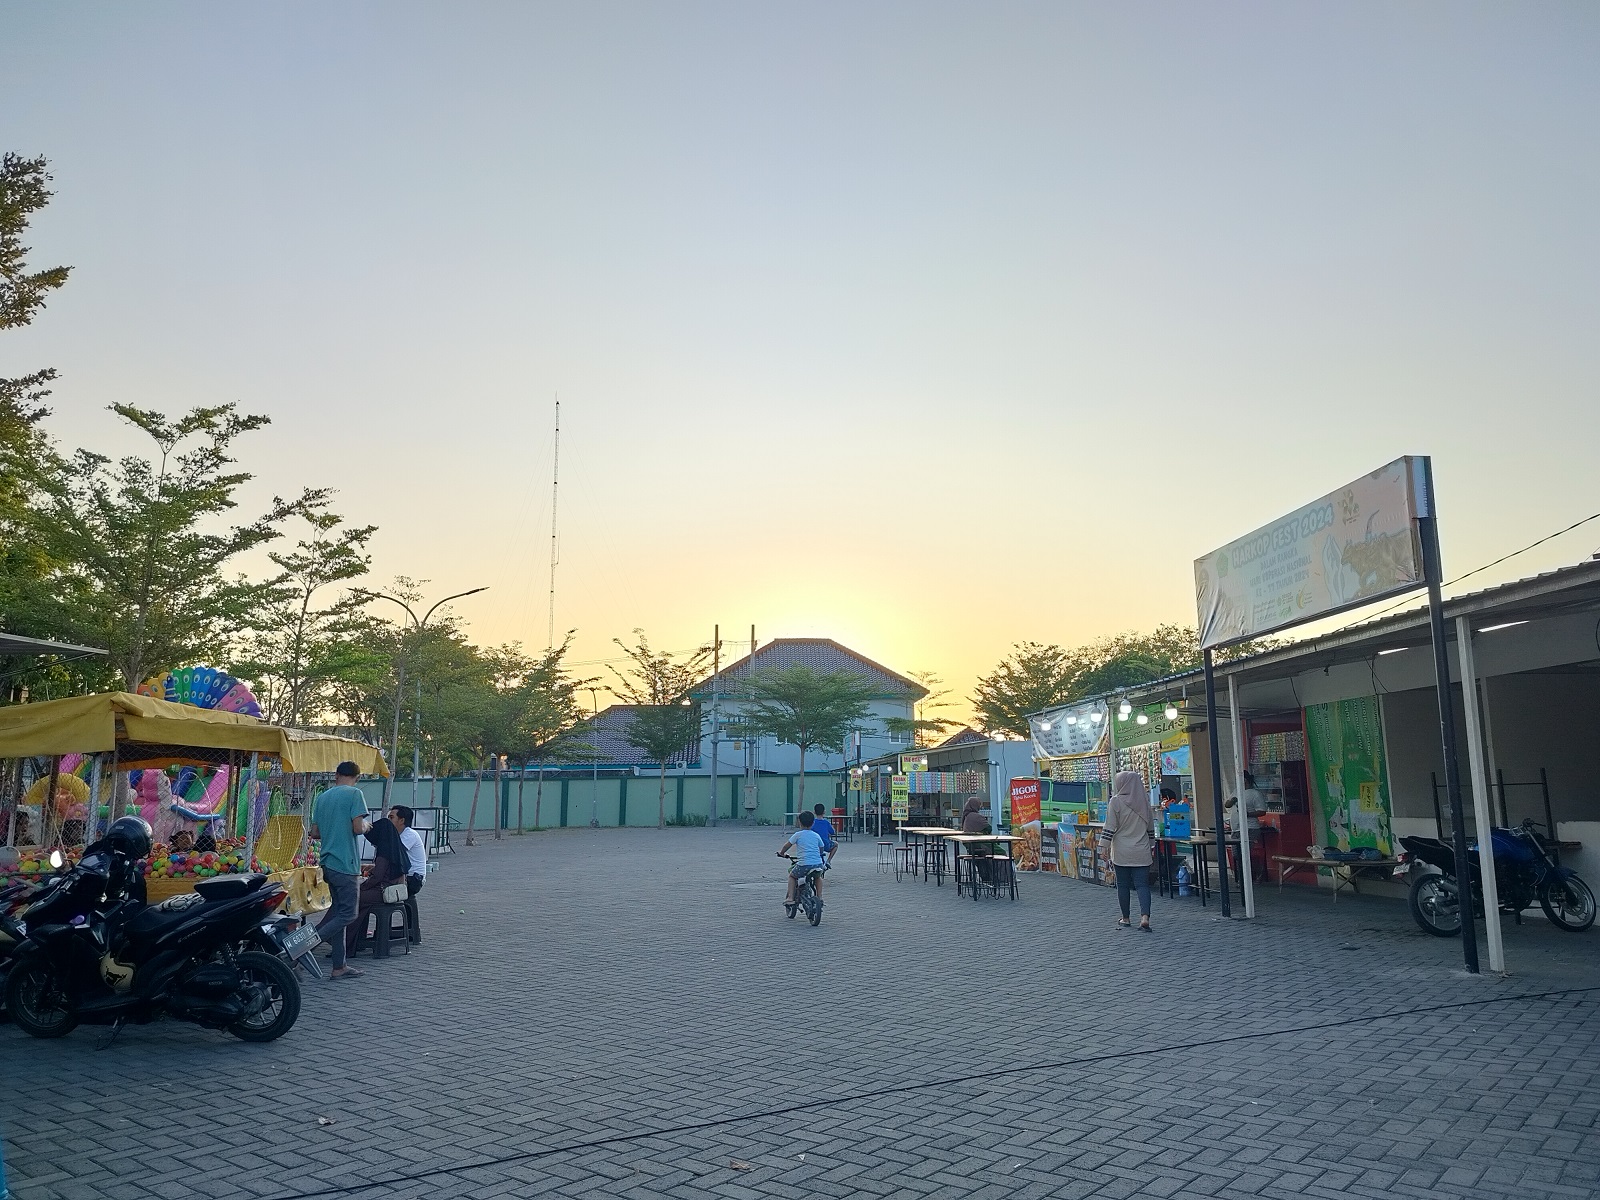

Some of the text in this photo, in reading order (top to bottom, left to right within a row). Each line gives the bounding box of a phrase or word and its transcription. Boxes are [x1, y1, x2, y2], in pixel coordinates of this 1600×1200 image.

[1232, 535, 1270, 567] HARKOP
[1273, 520, 1299, 550] FEST
[1302, 505, 1333, 536] 2024
[1011, 784, 1038, 796] JIGOR
